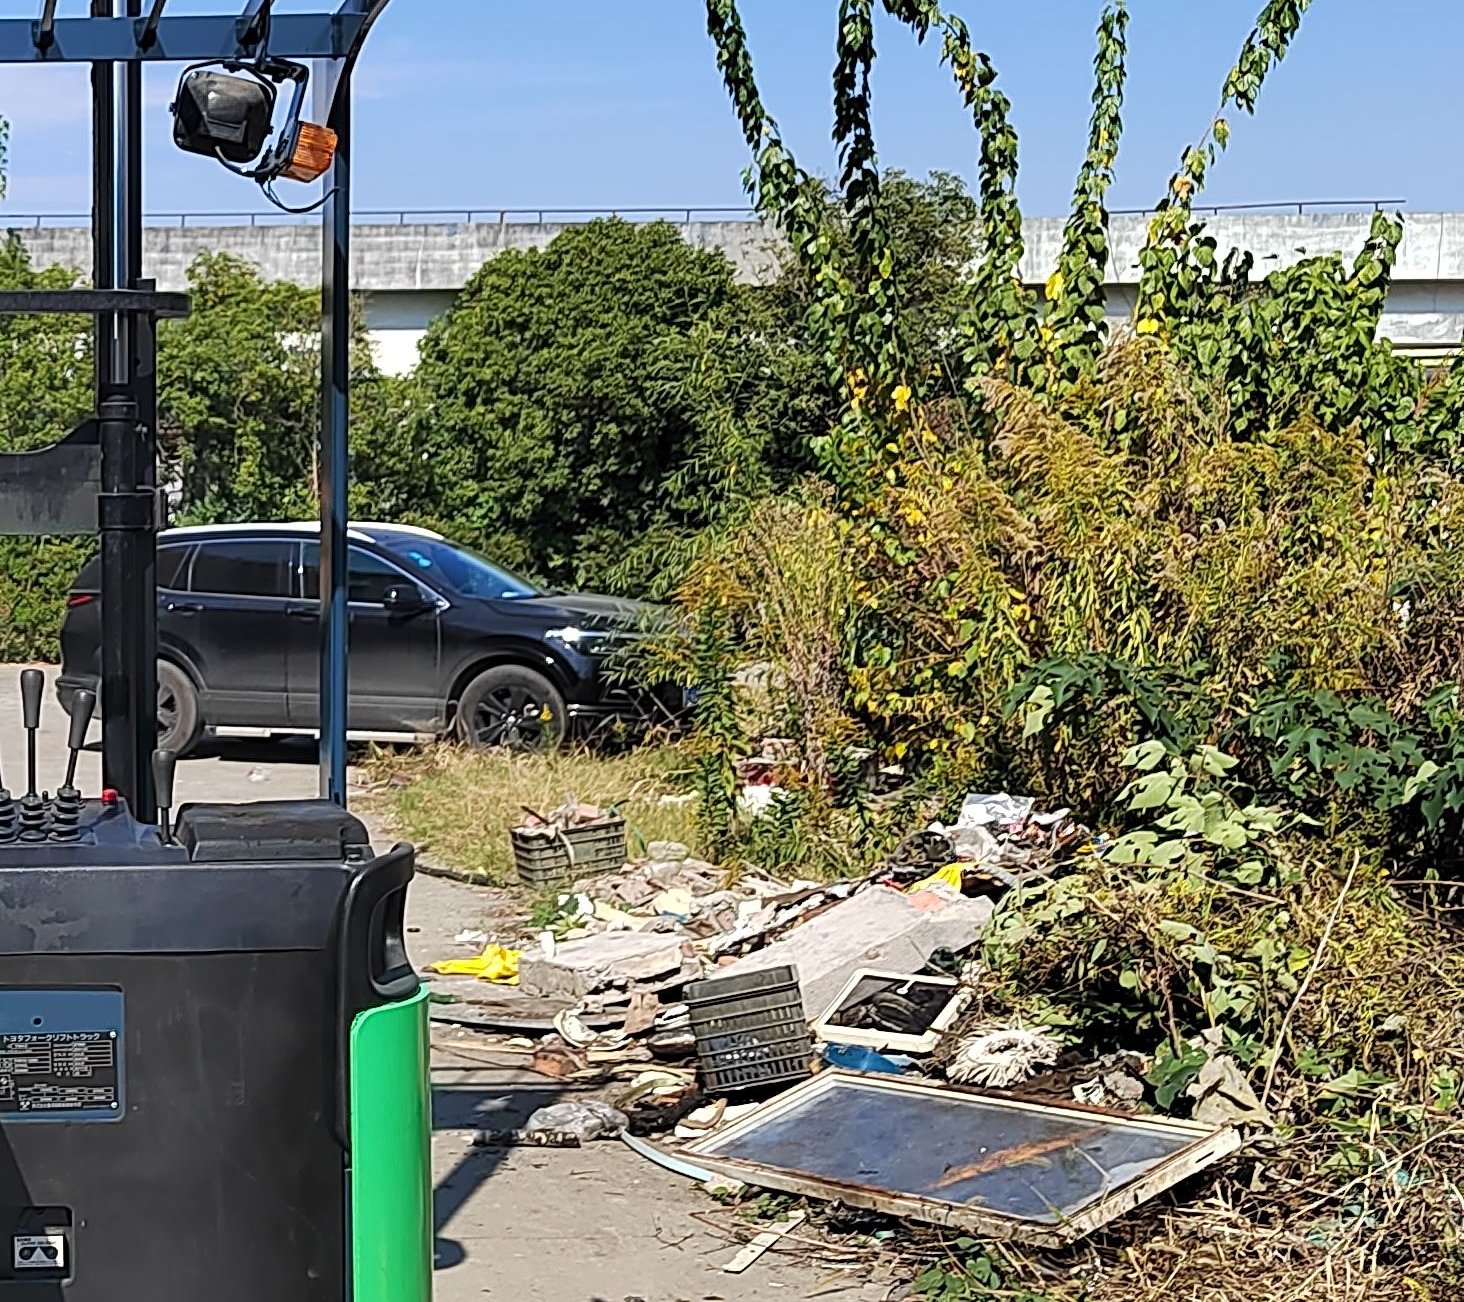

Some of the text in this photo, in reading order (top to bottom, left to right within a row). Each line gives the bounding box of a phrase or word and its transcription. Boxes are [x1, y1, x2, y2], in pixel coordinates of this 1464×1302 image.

[3, 1033, 100, 1042] トヨタフォークリフトトラック
